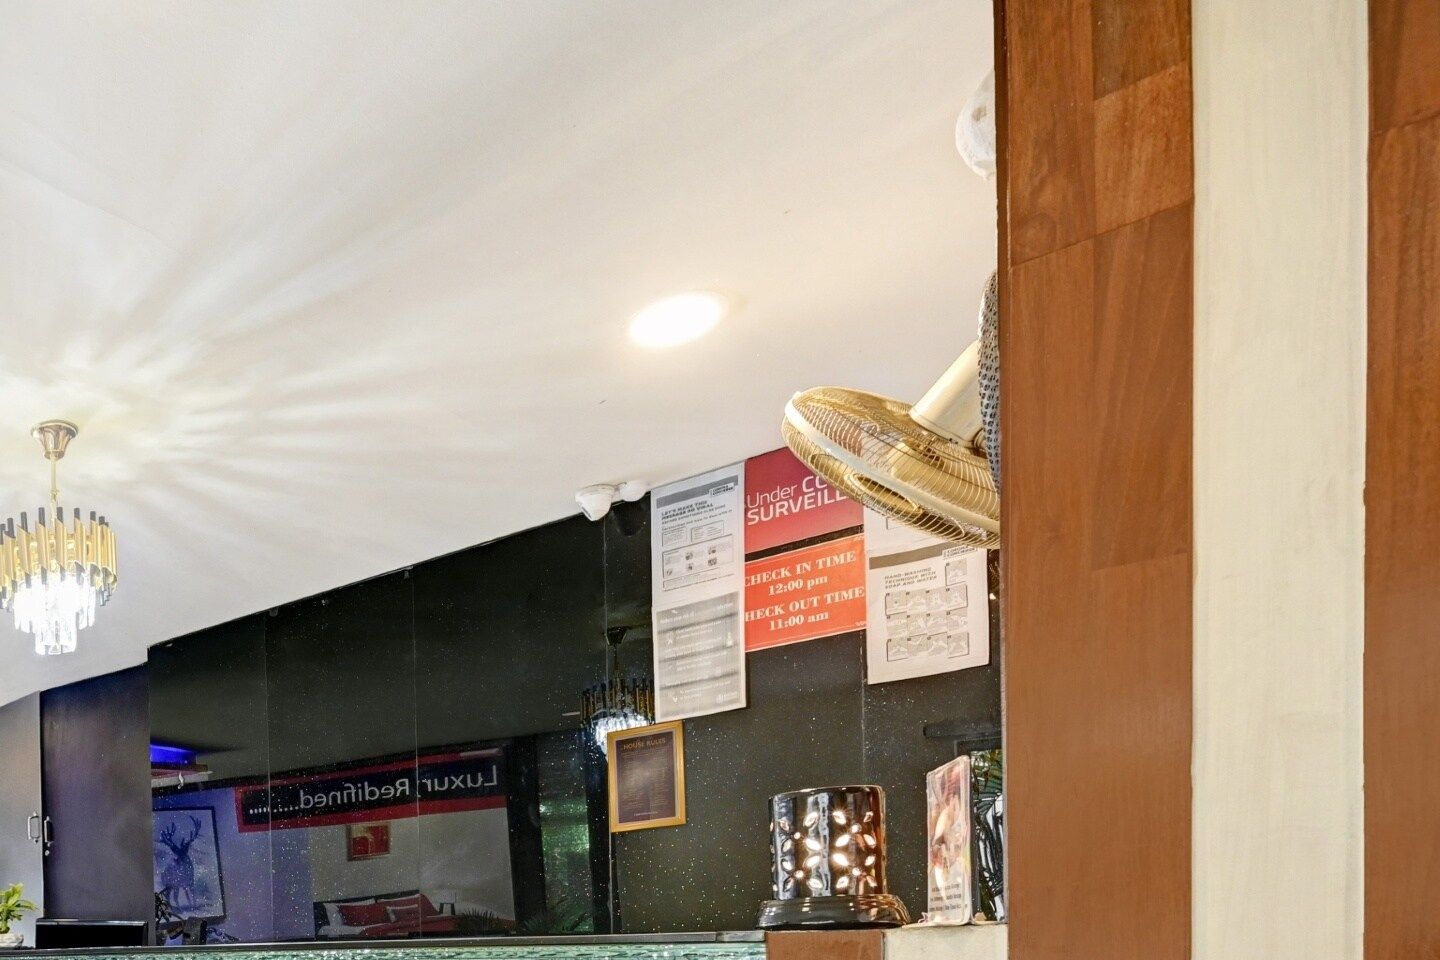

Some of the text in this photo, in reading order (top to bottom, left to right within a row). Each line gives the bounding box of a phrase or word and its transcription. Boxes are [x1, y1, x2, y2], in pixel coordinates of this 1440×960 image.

[747, 484, 798, 508] Under
[747, 489, 849, 526] SURVEILL
[745, 551, 856, 587] CHECK IN TIME
[768, 575, 828, 596] 12:00 pm
[745, 604, 786, 622] HECK
[788, 595, 821, 613] OUT
[823, 586, 865, 605] TIME
[769, 611, 829, 631] 11:00 am
